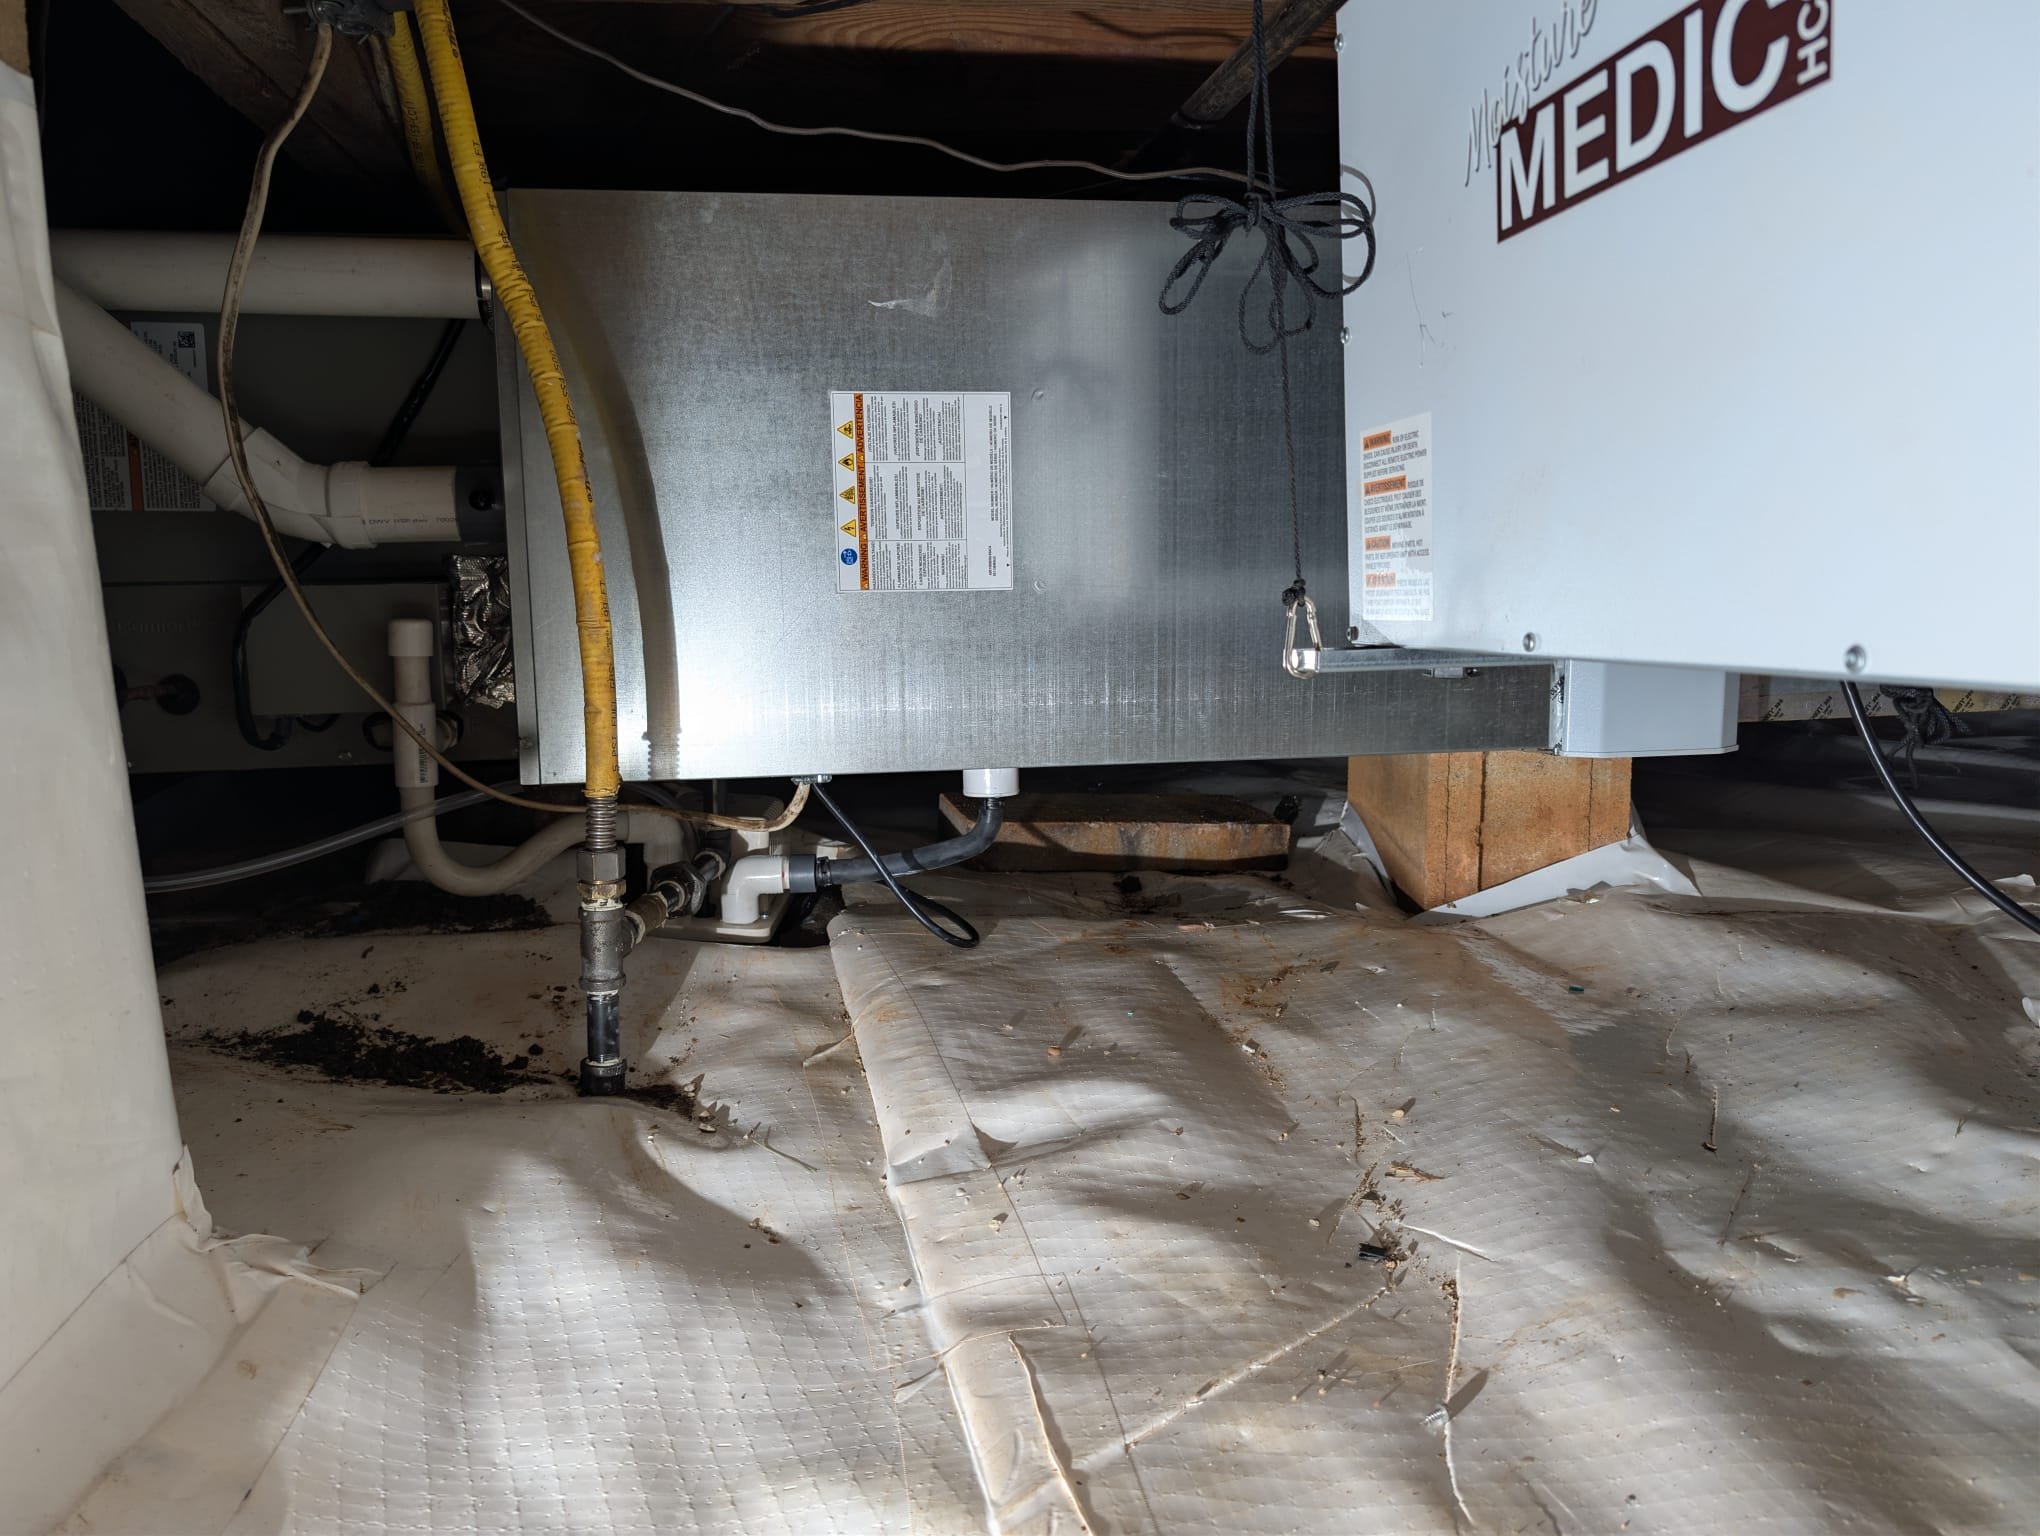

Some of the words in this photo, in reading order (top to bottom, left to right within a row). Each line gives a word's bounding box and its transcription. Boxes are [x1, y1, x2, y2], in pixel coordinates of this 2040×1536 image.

[1465, 0, 1599, 187] Moisture
[1499, 0, 1790, 232] MEDIC
[855, 394, 864, 453] ADVERTENCIA
[858, 465, 867, 531] AVERTISSEMENT
[860, 543, 868, 582] WARNING
